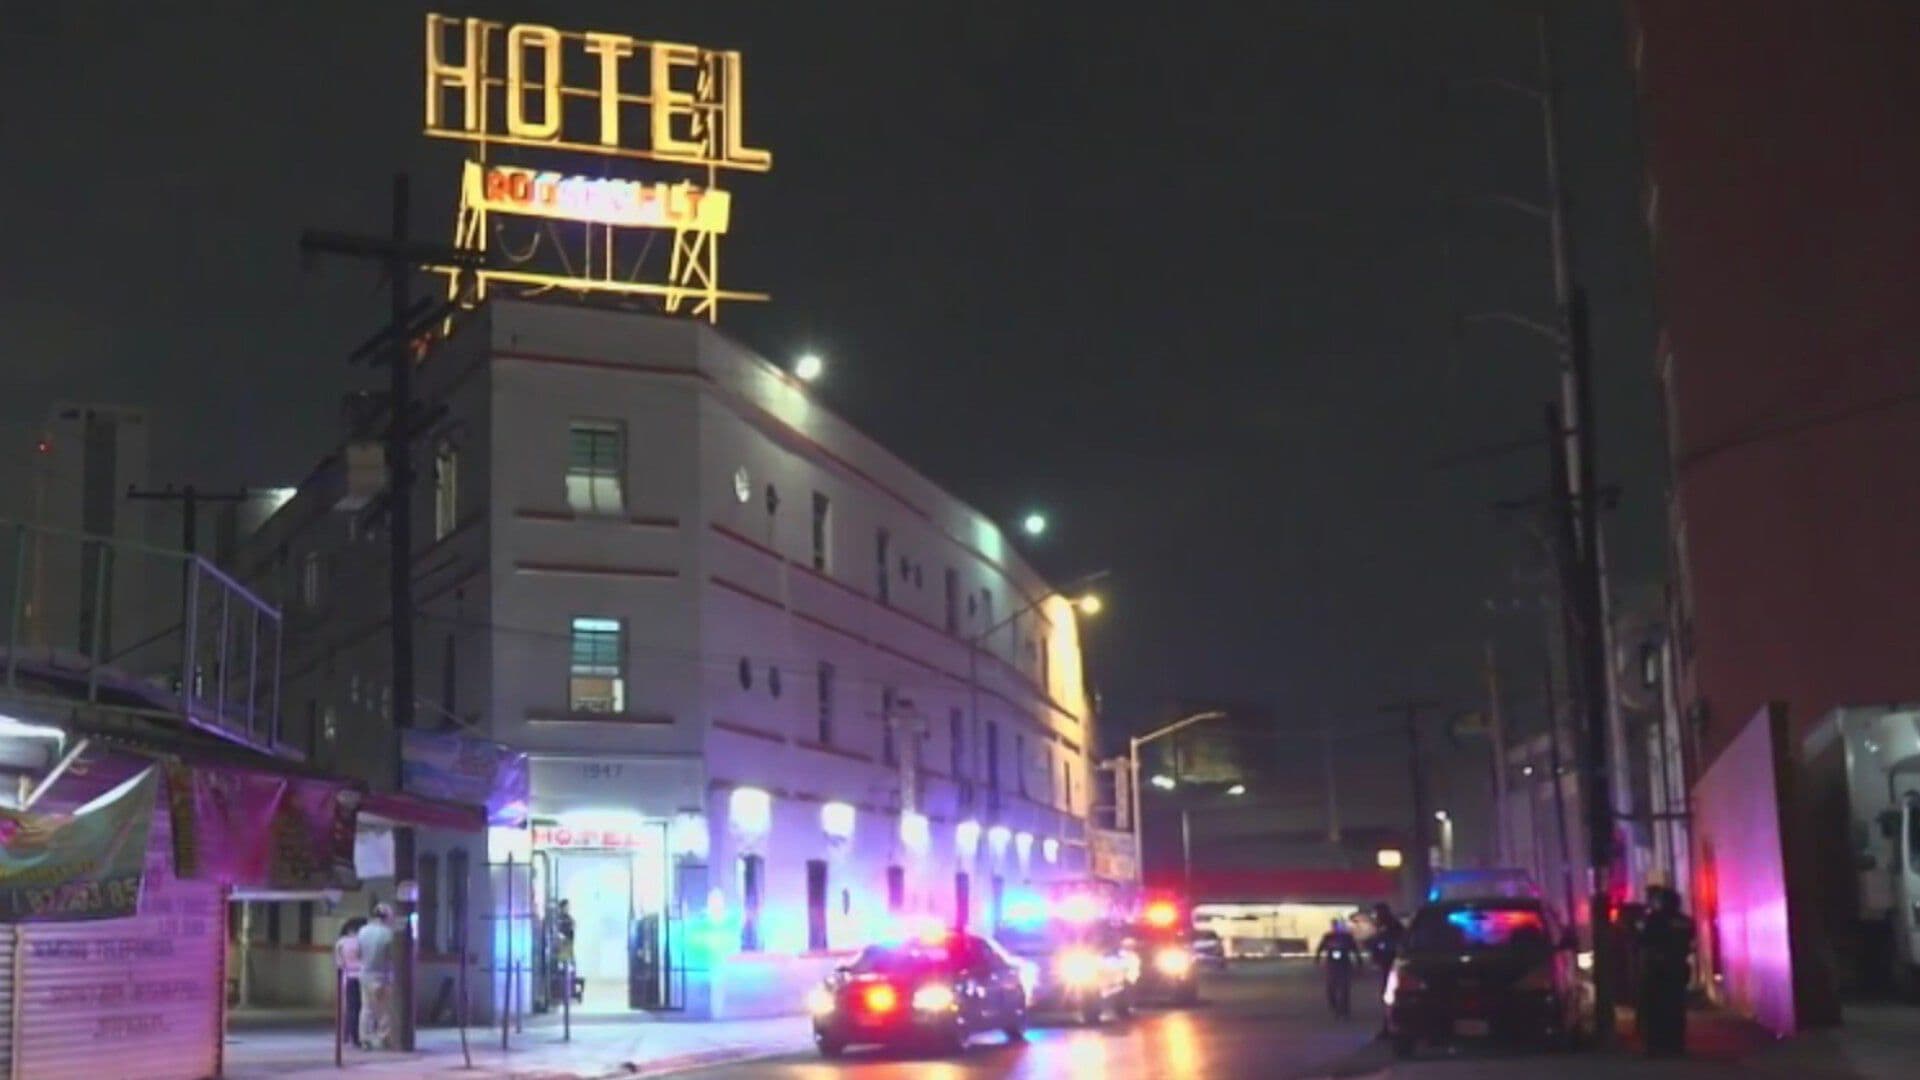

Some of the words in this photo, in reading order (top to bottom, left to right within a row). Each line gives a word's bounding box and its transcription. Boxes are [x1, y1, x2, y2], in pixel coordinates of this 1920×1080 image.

[426, 13, 771, 170] HOTEL
[582, 764, 624, 779] 1947
[533, 829, 641, 847] HOTEL
